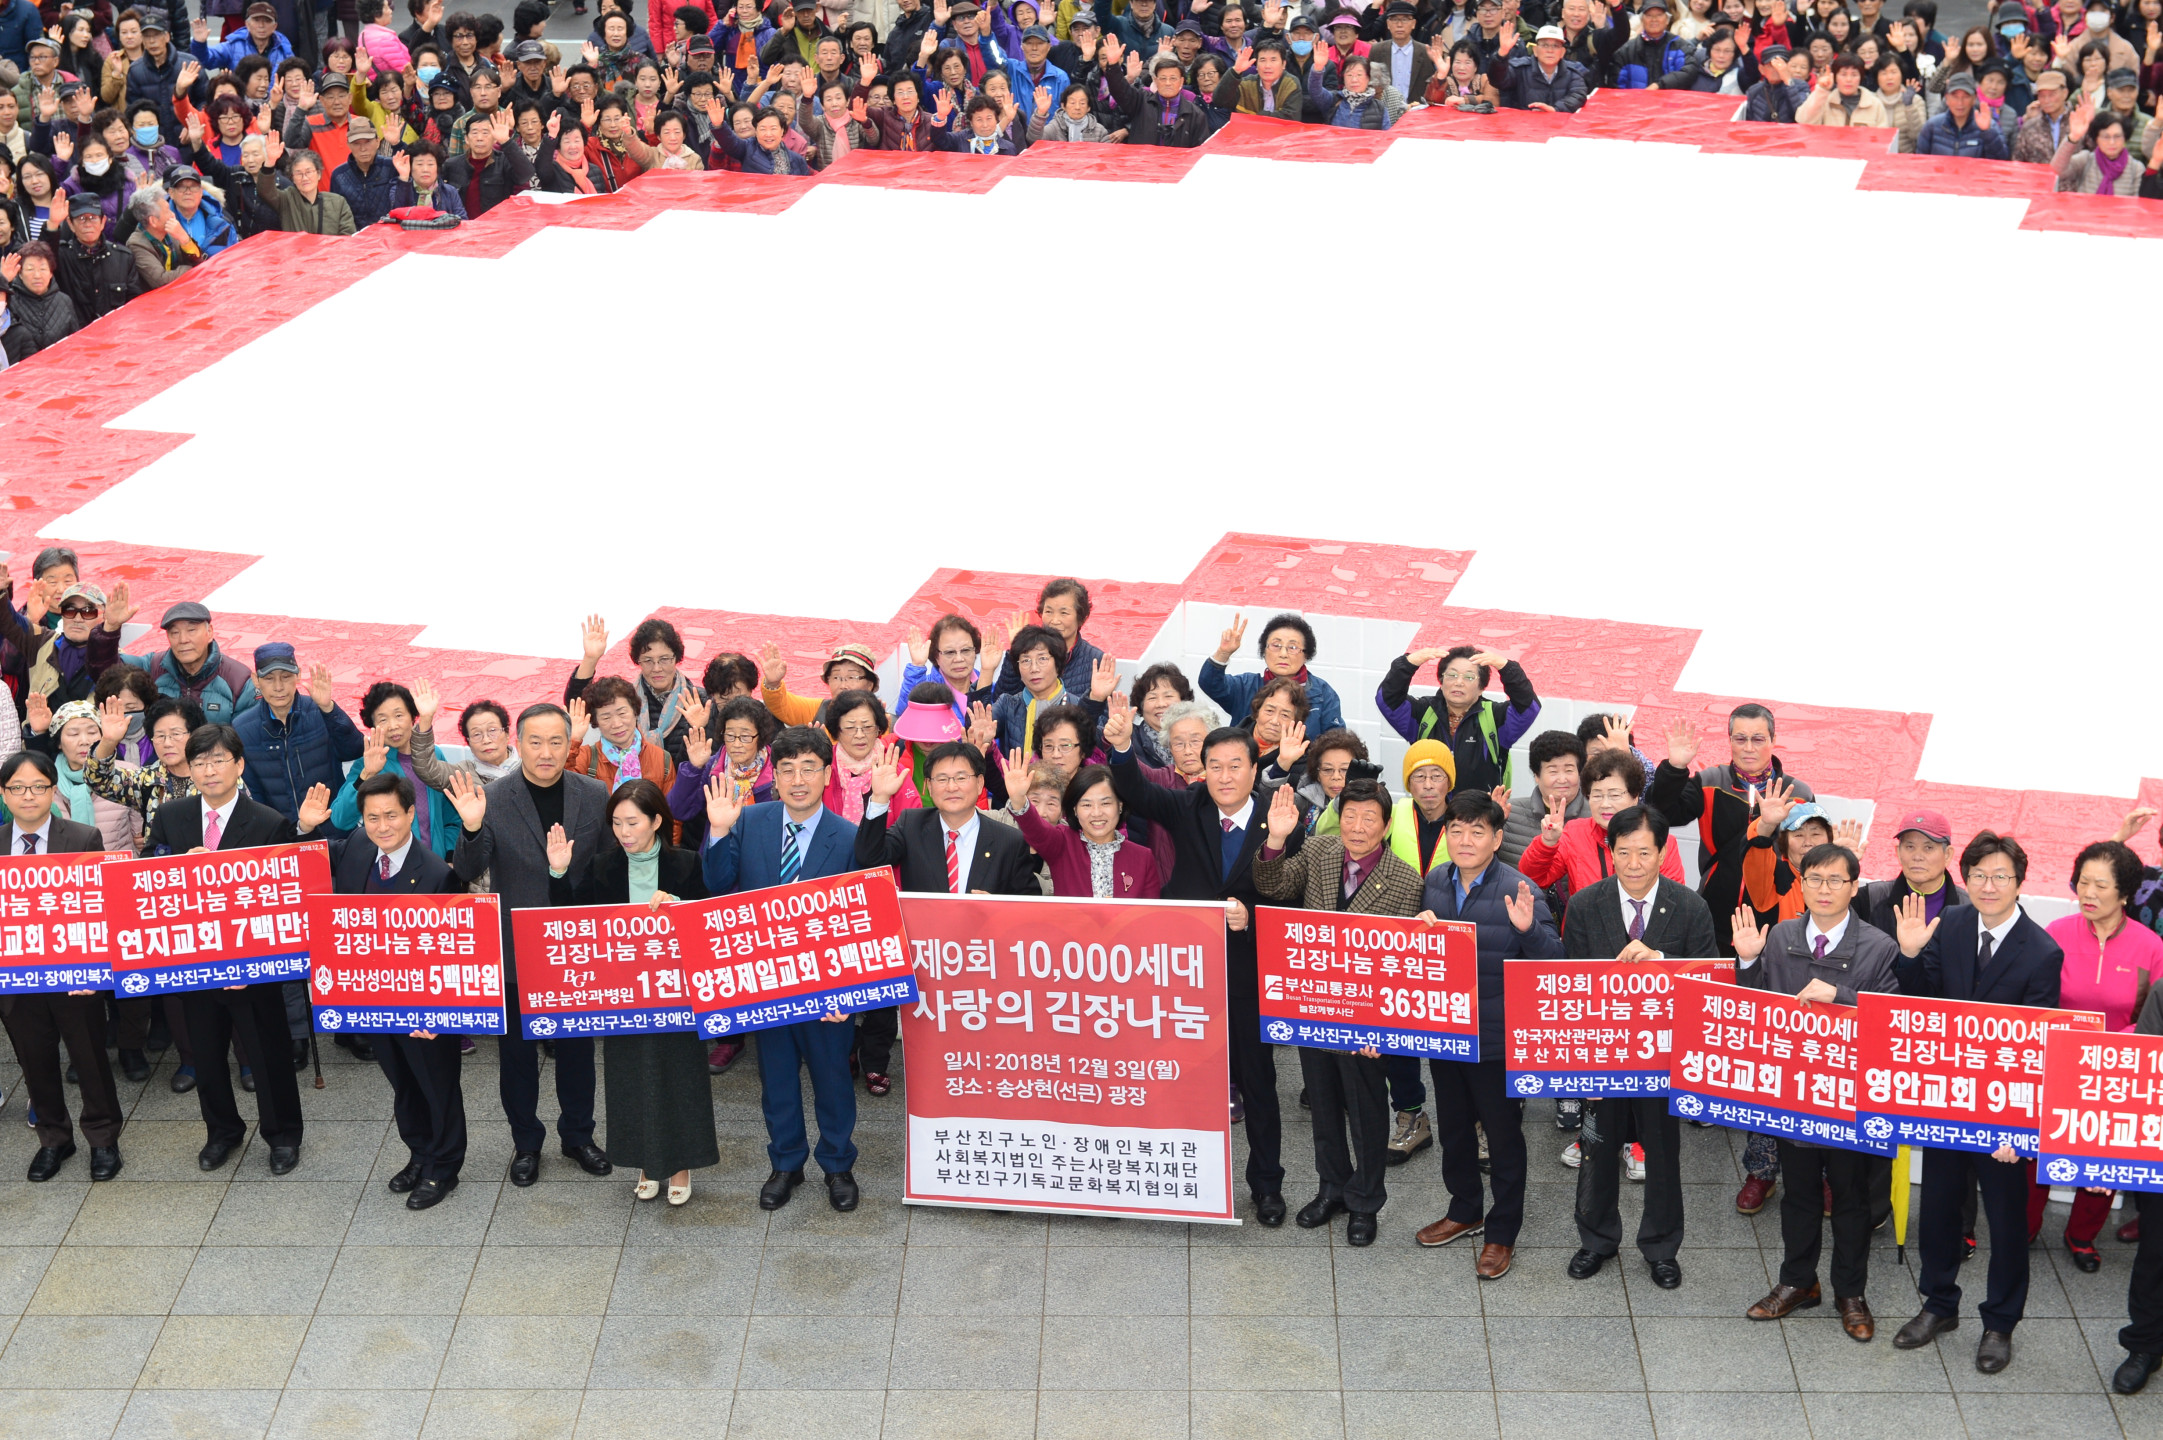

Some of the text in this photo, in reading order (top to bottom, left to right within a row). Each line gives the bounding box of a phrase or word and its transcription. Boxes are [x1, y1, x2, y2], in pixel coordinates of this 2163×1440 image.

[132, 855, 300, 893] 제9회 10,000세대
[37, 891, 104, 915] 후원금
[136, 881, 303, 920] 김장나눔 후원금
[703, 883, 868, 933] 제9회 10,000세대
[332, 907, 475, 931] 제9회 10,000세대
[543, 915, 675, 941] 제9회 10,000
[709, 909, 872, 960] 김장나눔 후원금
[0, 923, 45, 956] 교회
[117, 919, 223, 961] 연지교회
[333, 932, 476, 956] 김장나눔 후원금
[545, 941, 638, 966] 김장나눔
[1284, 922, 1446, 956] 제9회 10,000세대
[336, 964, 501, 997] 부산성의신협 5백만원
[691, 935, 906, 1002] 양정제일교회 3백만원
[911, 938, 1204, 989] 제9회 10,000세대
[1285, 947, 1448, 982] 김장나눔 후원금
[527, 968, 691, 1008] 밝은눈안과병원 1천
[1285, 977, 1471, 1024] 부산교통공사 363만원
[1303, 995, 1341, 1005] Transportation
[1341, 998, 1374, 1008] Corporation
[1535, 972, 1711, 997] 제9회 10,000
[346, 1011, 500, 1029] 부산진구노인·장애인복지관
[735, 982, 910, 1027] 부산진구노인·장애인복지관
[912, 988, 1210, 1040] 사랑의 김장나눔
[1537, 999, 1633, 1021] 김장나눔
[1702, 994, 1857, 1042] 제9회 10,000세
[1298, 1025, 1471, 1055] 부산진구노인·장애인복지관
[1512, 1028, 1630, 1045] 한국자산관리공사
[1701, 1021, 1794, 1059] 김장나눔
[1889, 1009, 2070, 1047] 제9회 10,000세
[944, 1051, 982, 1072] 일시
[994, 1052, 1062, 1074] 2018년
[1068, 1057, 1109, 1079] 12월
[1114, 1059, 1181, 1082] 3일(월)
[1889, 1037, 1988, 1070] 김장나눔
[2078, 1045, 2140, 1074] 제9회
[1680, 1050, 1782, 1098] 성안교회
[945, 1077, 984, 1097] 장소
[996, 1078, 1102, 1105] 송상현(선큰)
[1107, 1085, 1147, 1107] 광장
[1865, 1067, 2043, 1118] 영안교회 9백
[1708, 1102, 1888, 1150] 부산진구노인·장애인복
[2049, 1108, 2163, 1151] 가야교회
[935, 1149, 1198, 1179] 사회복지법인 주는사랑복지재단
[936, 1168, 1199, 1199] 부산진구기독교문화복지협의회
